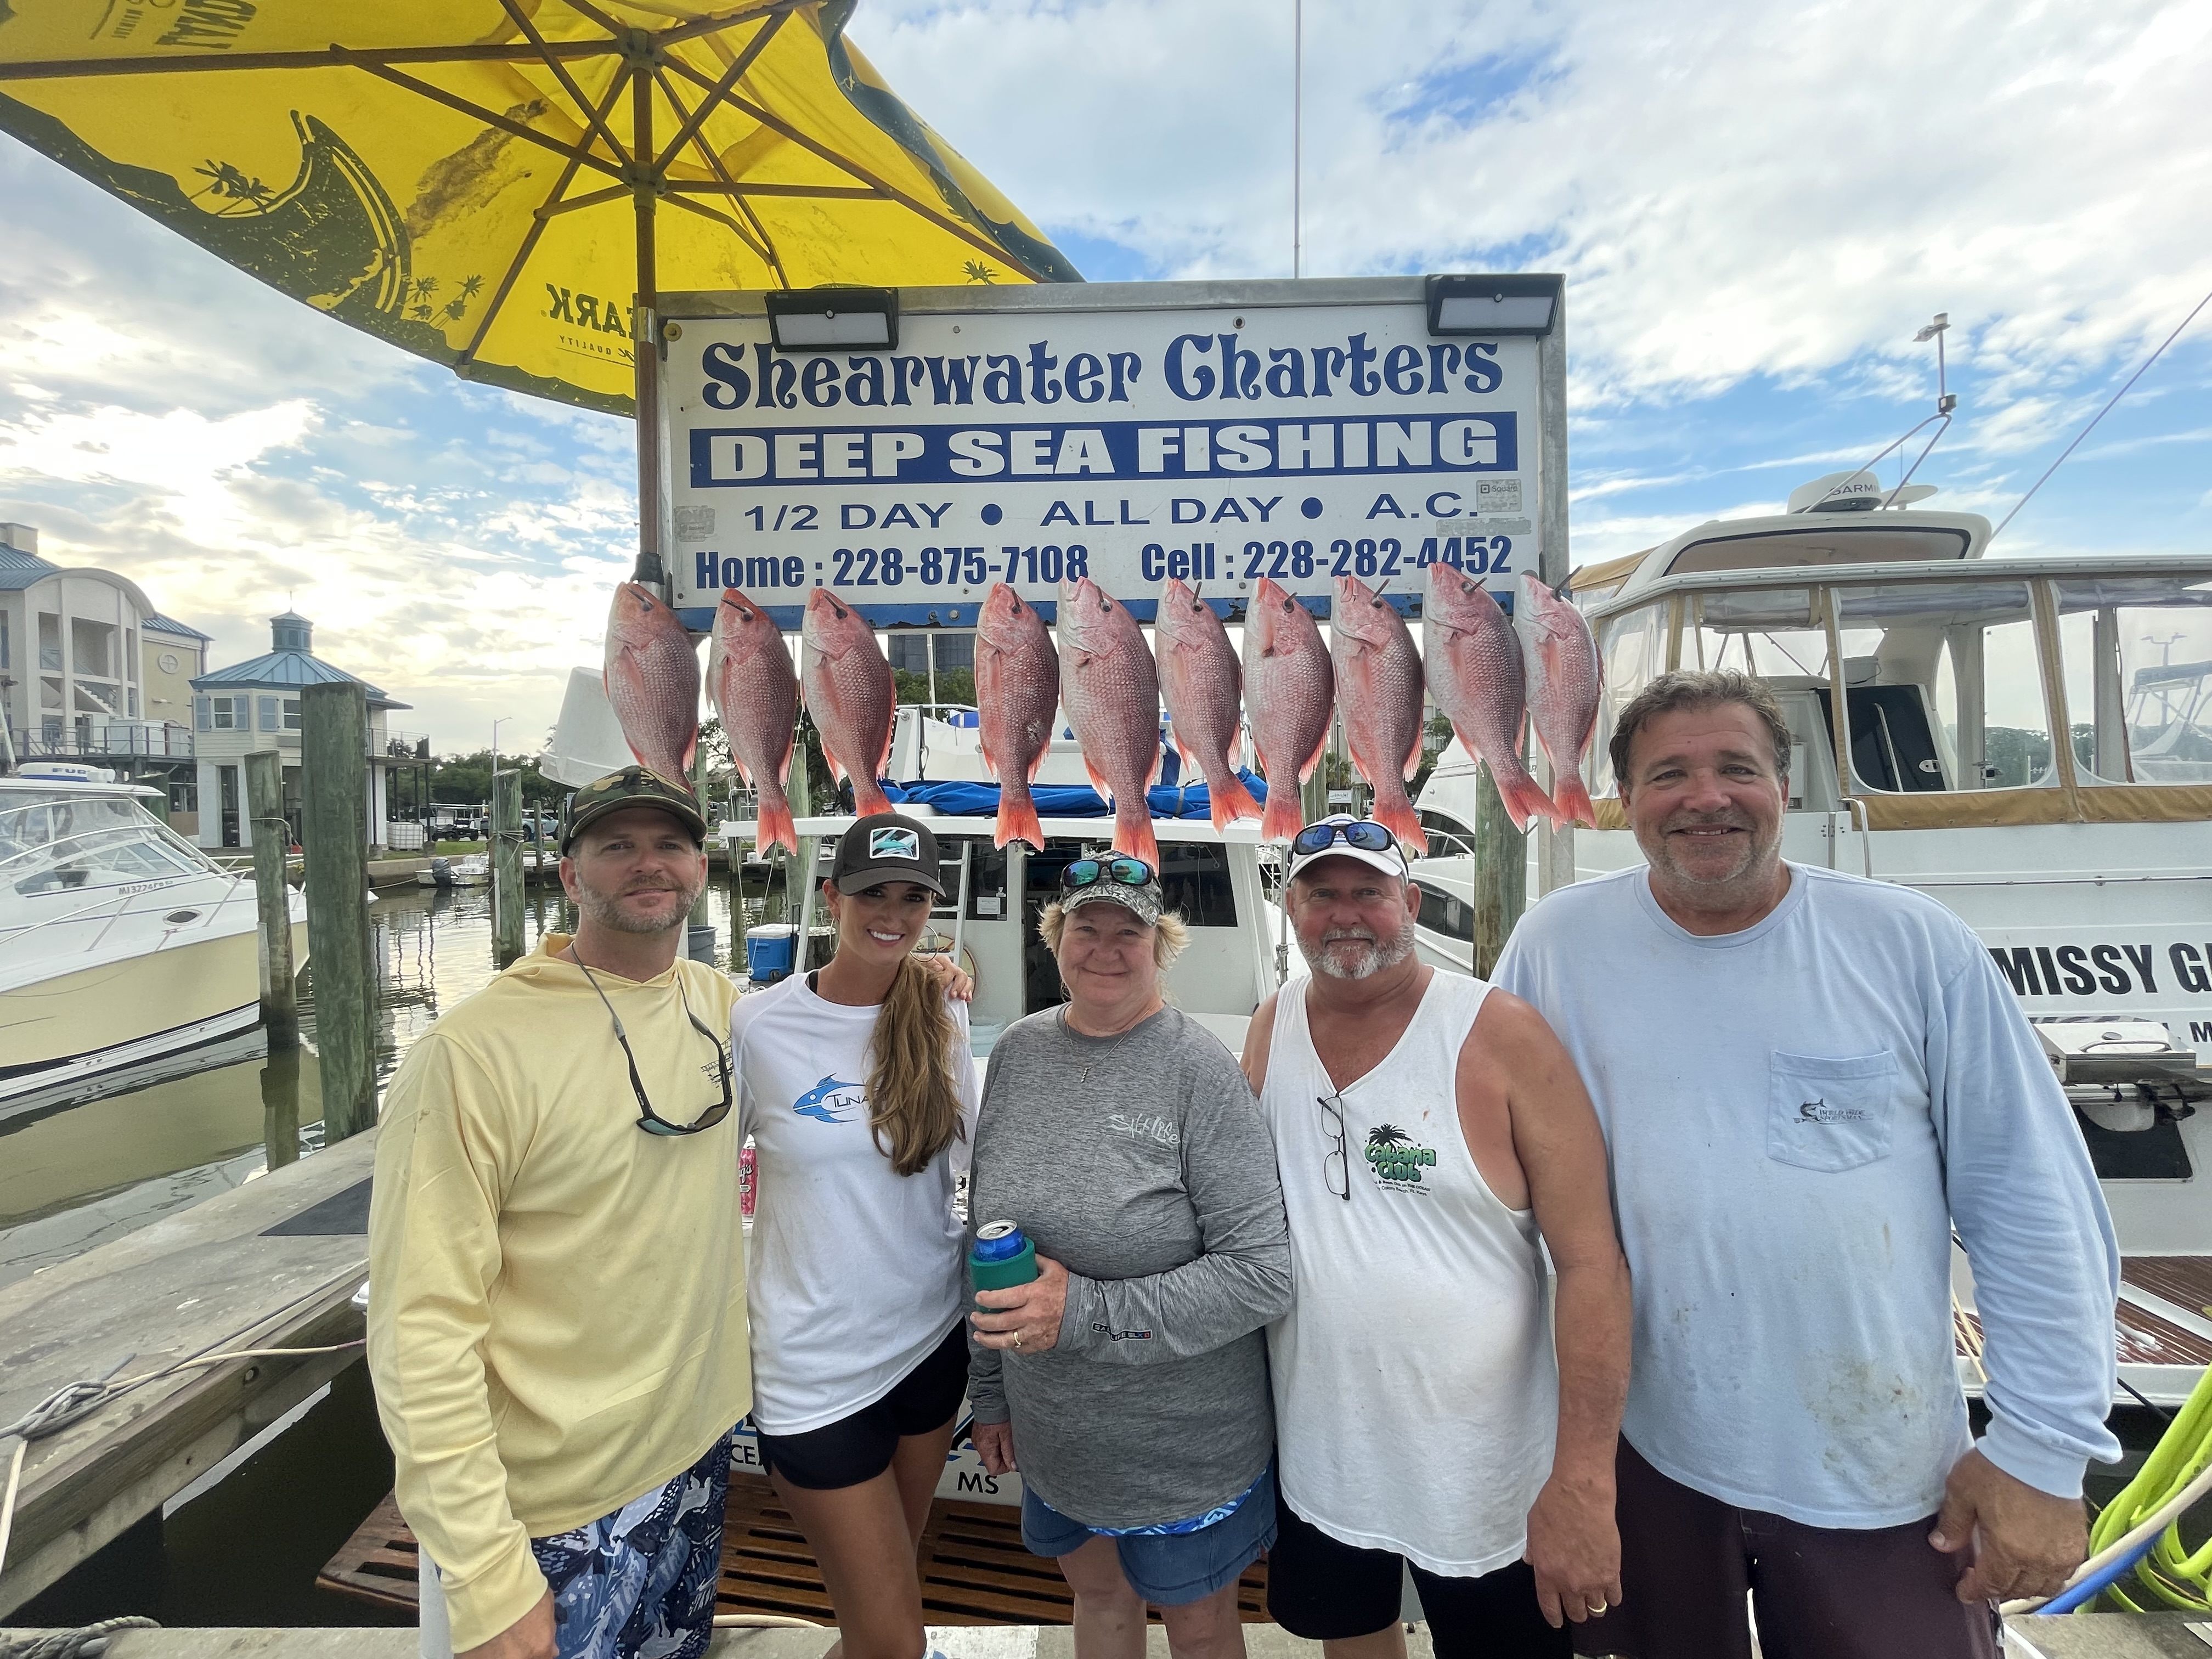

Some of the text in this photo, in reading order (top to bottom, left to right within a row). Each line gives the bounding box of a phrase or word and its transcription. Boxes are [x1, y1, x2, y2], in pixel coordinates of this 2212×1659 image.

[702, 331, 1503, 410] Shearwater Charters
[710, 419, 1497, 479] DEEP SEA FISHING
[1830, 484, 1878, 495] GARMI
[744, 505, 819, 531] 1/2
[841, 502, 953, 529] DAY
[1040, 500, 1149, 526] ALL
[1171, 496, 1283, 524] DAY
[1365, 492, 1478, 520] A.C.
[832, 545, 1088, 586] 228-875-7108
[1243, 535, 1512, 579] 228-282-4452
[1987, 942, 2212, 996] MISSY G
[1364, 1143, 1436, 1167] Cabana
[1375, 1160, 1422, 1182] Club
[957, 1471, 999, 1494] MS
